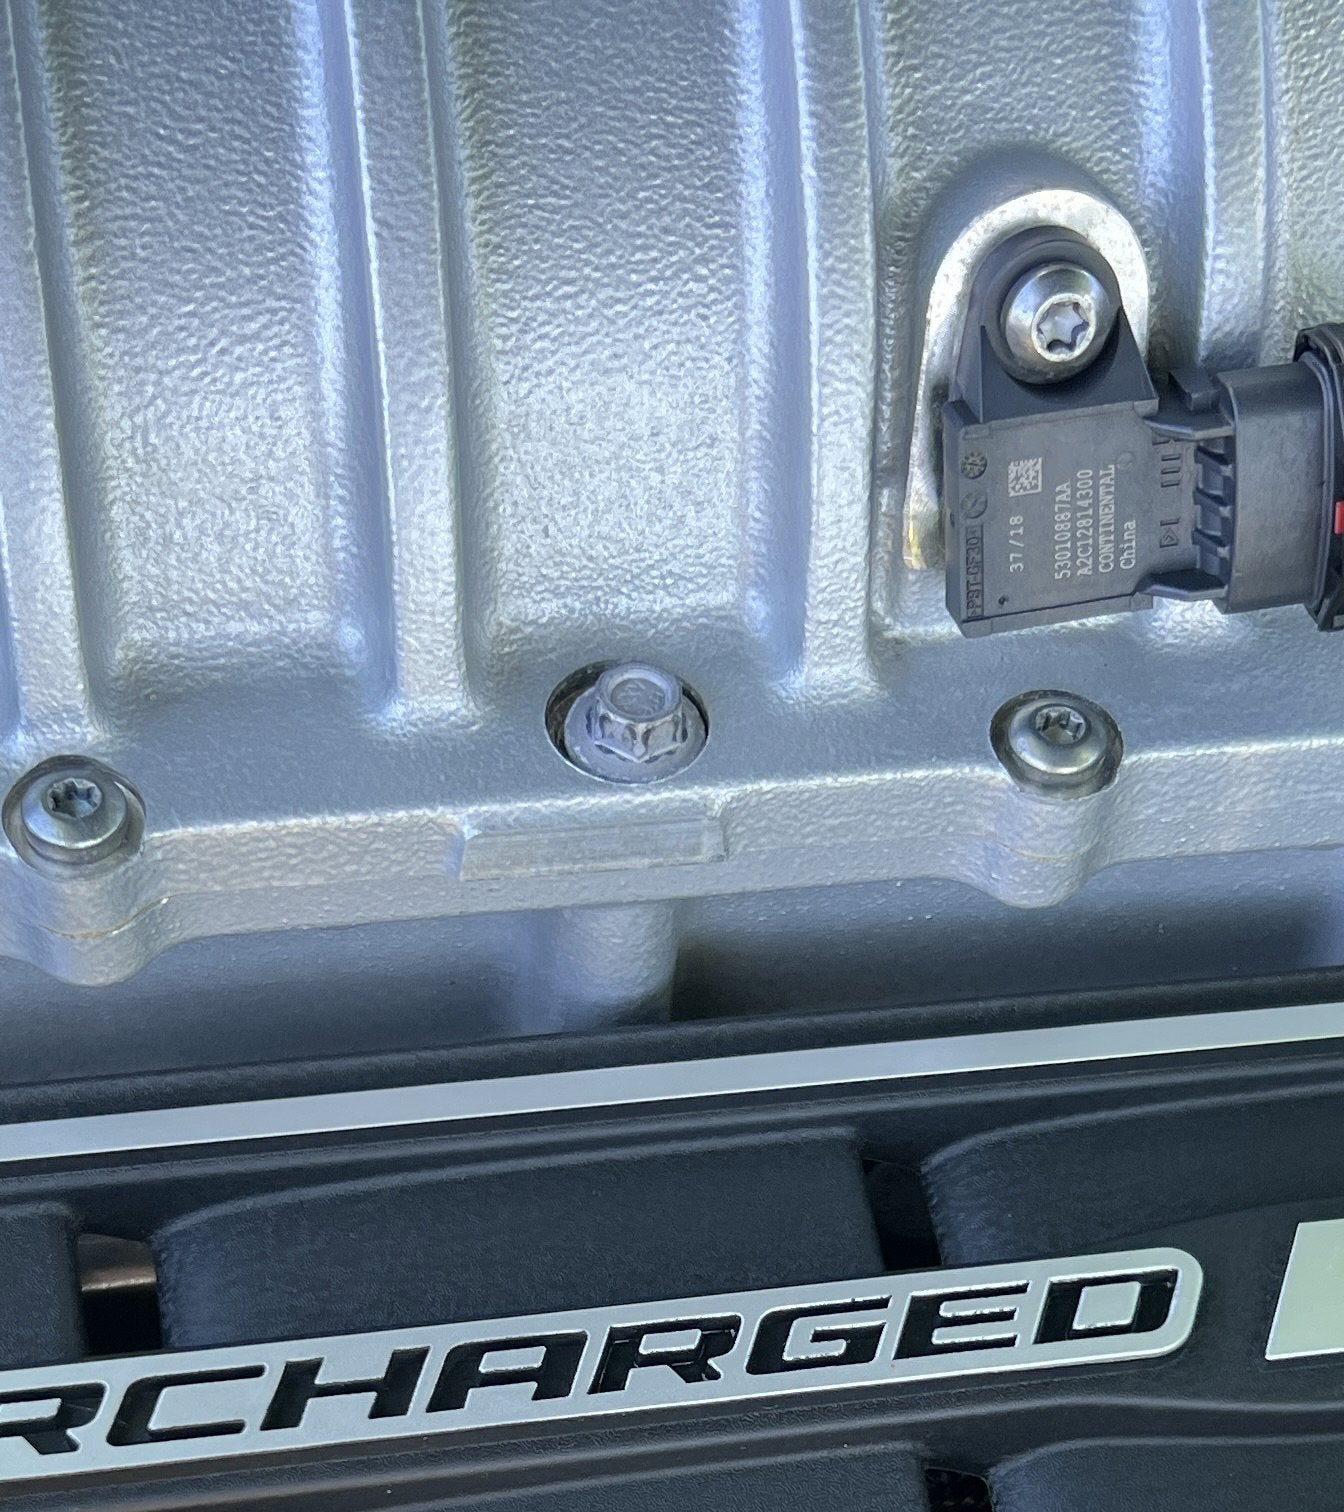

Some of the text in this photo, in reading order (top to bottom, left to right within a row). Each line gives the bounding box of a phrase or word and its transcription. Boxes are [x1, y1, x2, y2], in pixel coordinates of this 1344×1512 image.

[1008, 515, 1025, 573] 37/18
[1053, 481, 1072, 581] 53010887AA
[1074, 467, 1094, 577] A2C12814300
[1097, 463, 1117, 574] CONTINENTAL
[1119, 519, 1137, 570] China
